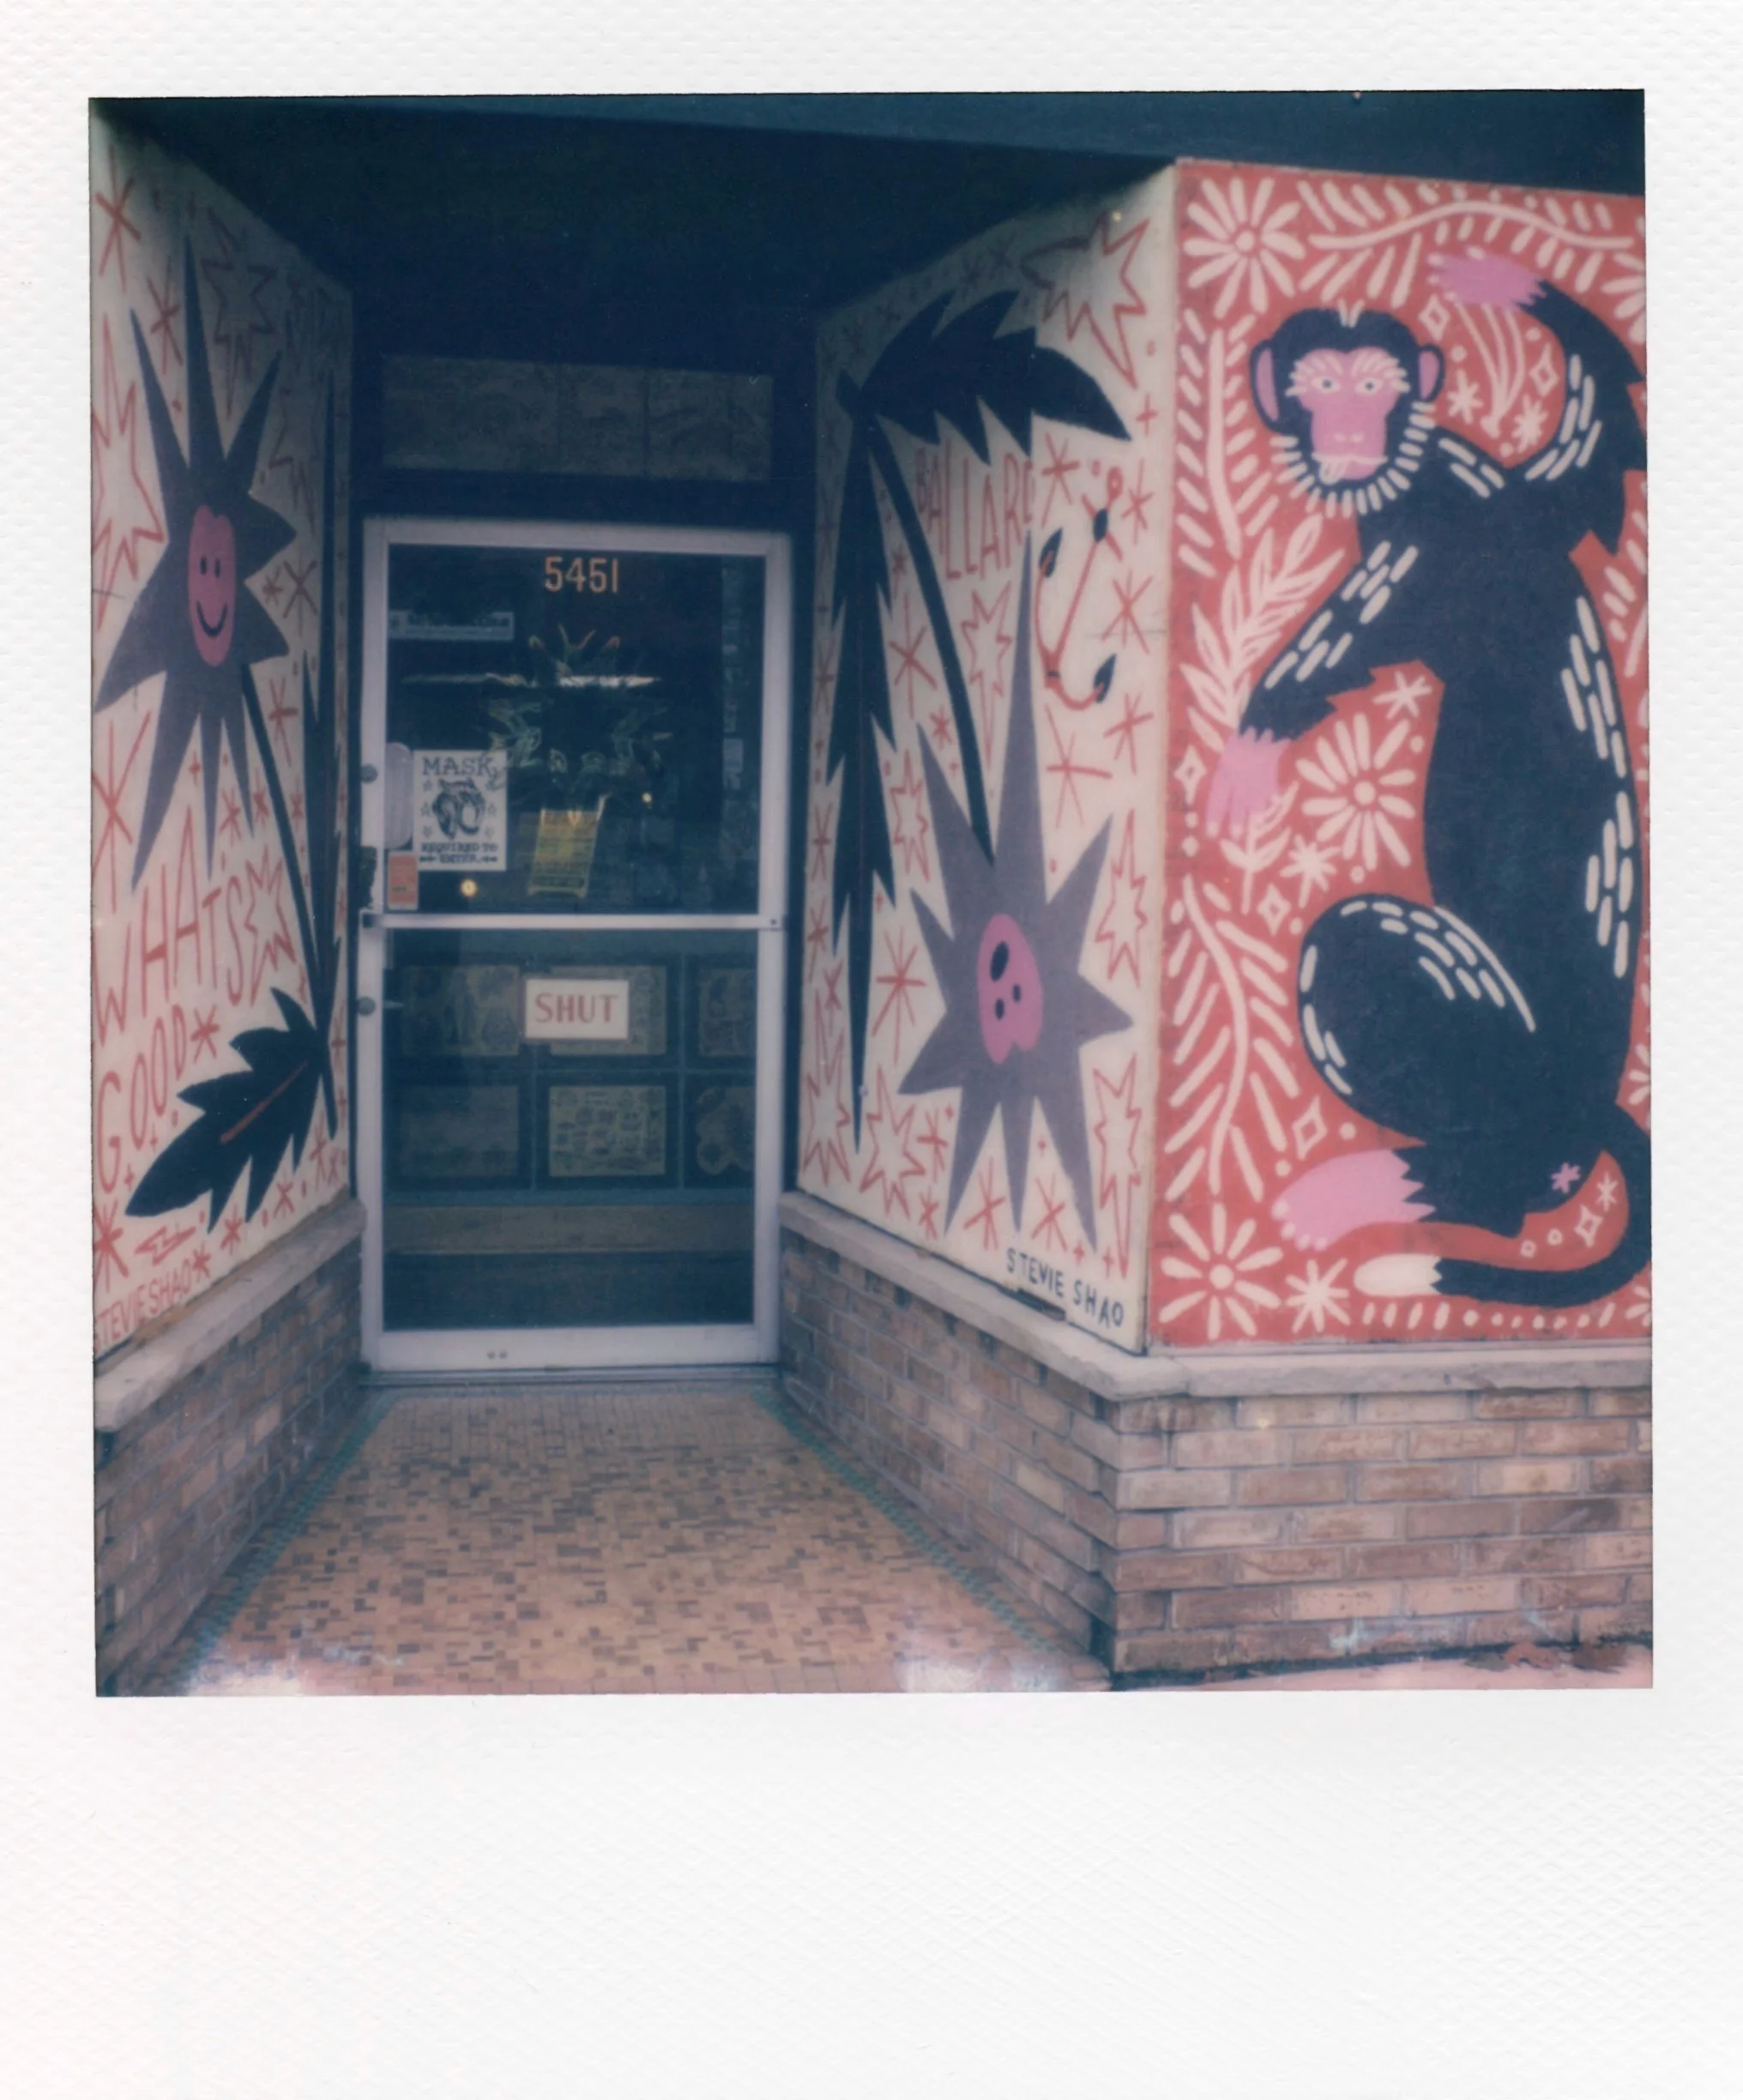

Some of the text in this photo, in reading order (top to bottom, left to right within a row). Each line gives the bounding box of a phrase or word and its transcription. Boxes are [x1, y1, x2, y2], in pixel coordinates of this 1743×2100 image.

[915, 438, 1035, 580] BALLARD
[543, 555, 619, 593] 5451
[422, 756, 493, 776] MASK
[92, 804, 244, 1044] WHATS
[534, 992, 618, 1024] SHUT
[97, 1004, 187, 1194] GOOD
[1006, 1247, 1125, 1328] STEVIE SHAO
